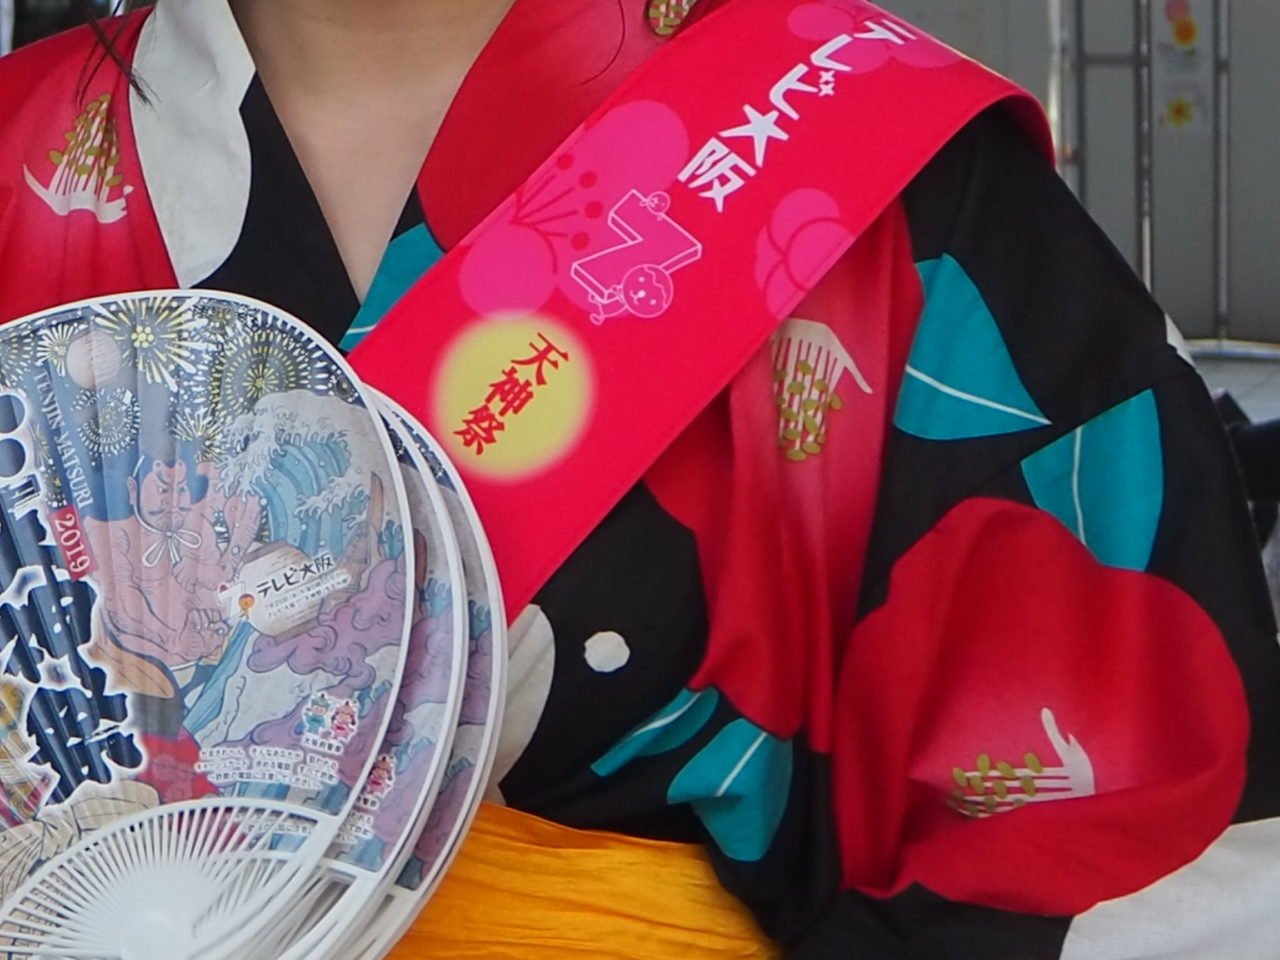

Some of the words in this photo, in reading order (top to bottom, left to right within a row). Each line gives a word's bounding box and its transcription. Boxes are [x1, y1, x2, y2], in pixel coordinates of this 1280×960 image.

[677, 19, 917, 213] テレビ大阪
[34, 369, 64, 430] TENJIN
[54, 430, 95, 510] MATSURI
[452, 331, 569, 456] 天神祭
[55, 512, 91, 574] 2019
[255, 552, 334, 599] テレビ大阪
